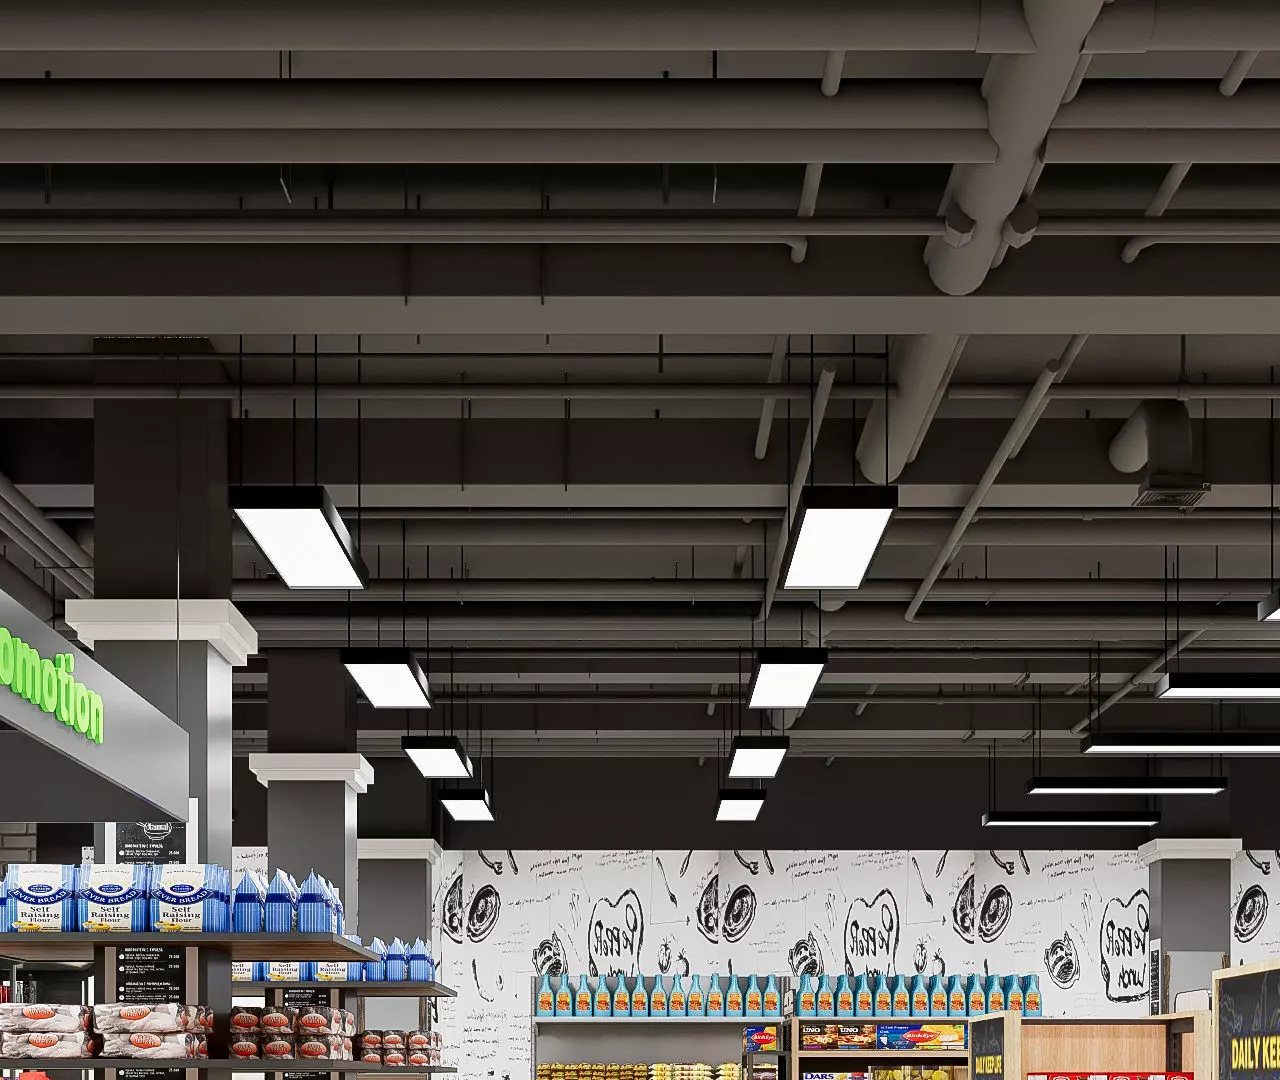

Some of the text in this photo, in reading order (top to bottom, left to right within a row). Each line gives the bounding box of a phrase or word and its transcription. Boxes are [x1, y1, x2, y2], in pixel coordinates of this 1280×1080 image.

[107, 890, 137, 904] BREAD
[20, 911, 60, 919] Raising
[90, 911, 130, 919] Raising
[1231, 1036, 1261, 1070] DAILY
[975, 1055, 985, 1074] DAILY
[985, 1055, 995, 1074] KEEP
